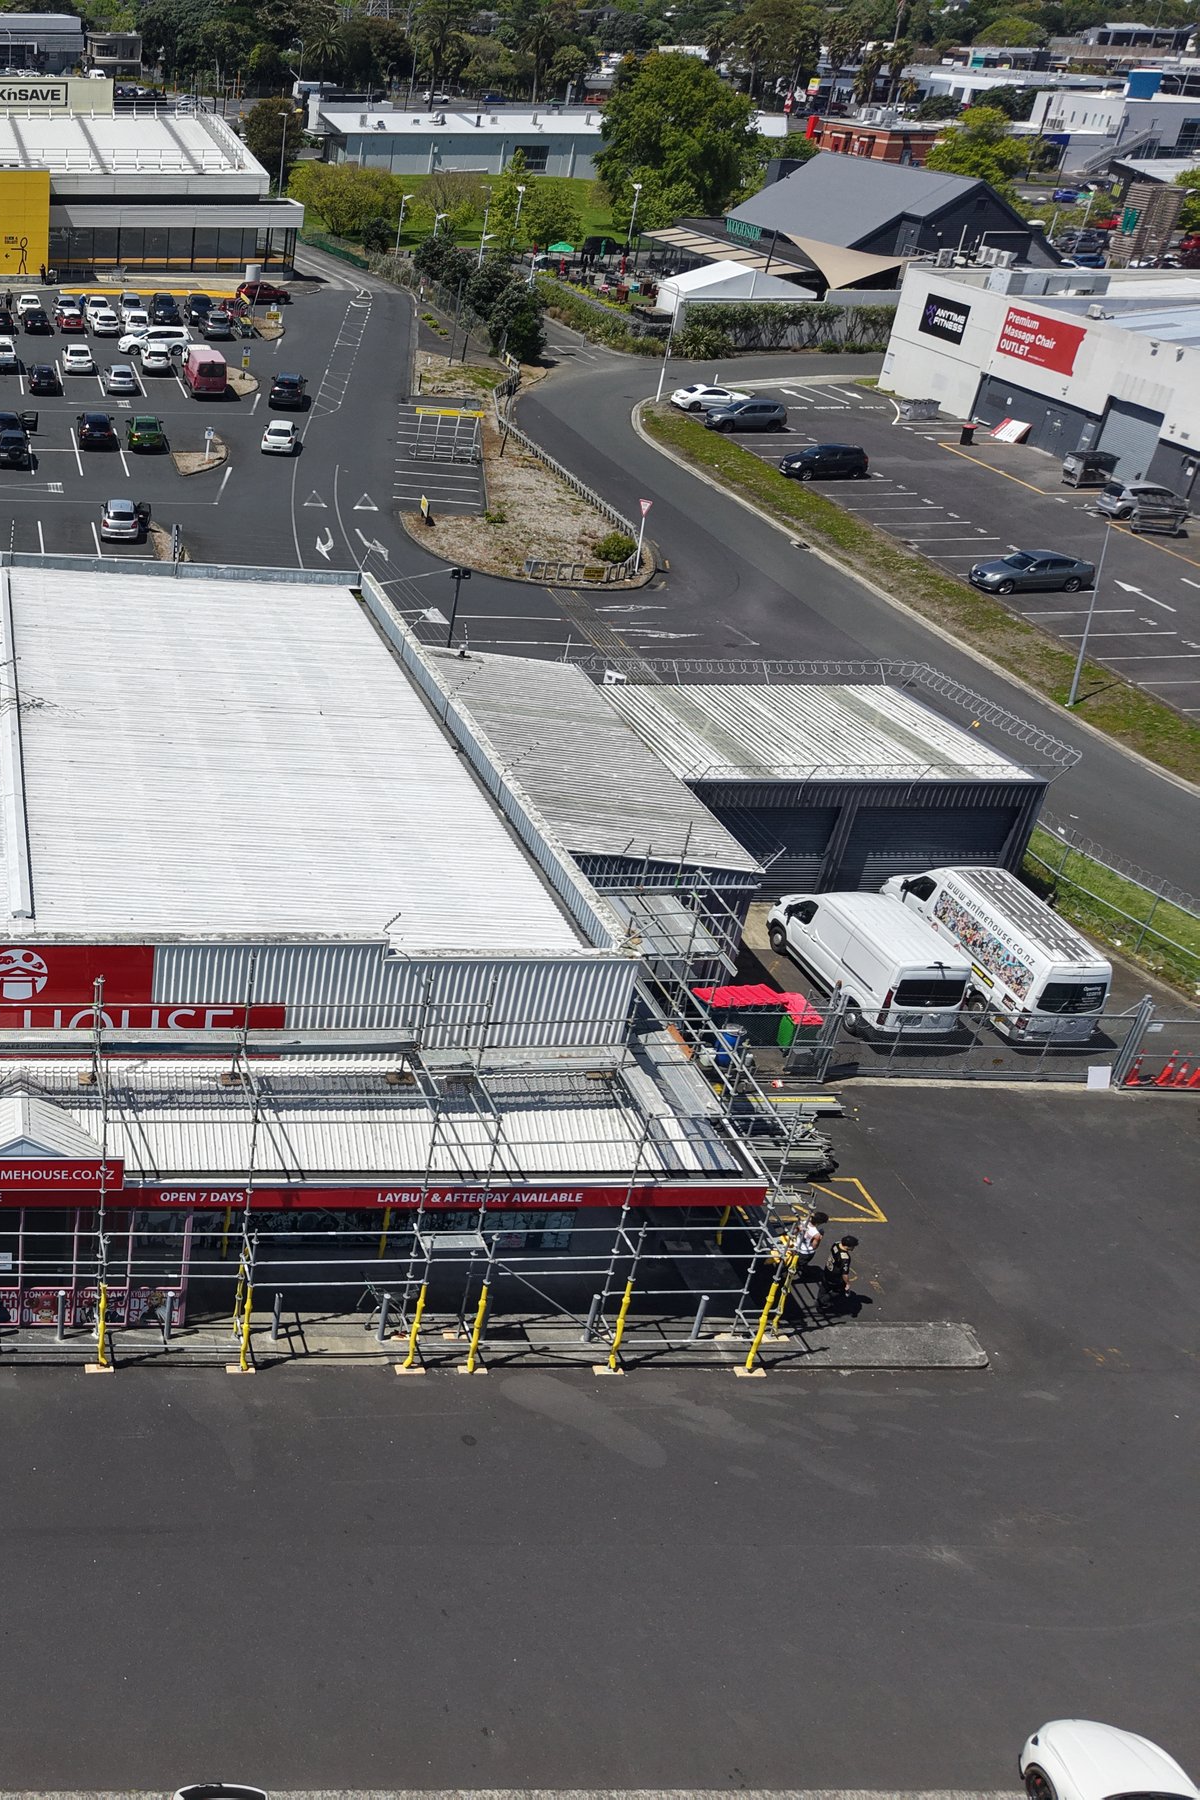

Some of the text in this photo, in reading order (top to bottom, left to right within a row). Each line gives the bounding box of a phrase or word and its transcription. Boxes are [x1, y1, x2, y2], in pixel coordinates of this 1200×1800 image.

[933, 316, 963, 333] FITNESS
[936, 308, 966, 324] ANYTIME
[1007, 311, 1040, 330] Premium
[1004, 324, 1057, 350] Massage Chair
[1000, 338, 1030, 357] OUTLET
[947, 881, 1036, 966] www.animehouse.co.nz
[160, 1192, 244, 1202] OPEN 7 DAYS
[377, 1192, 583, 1203] LAYBUY & AFTERPAY AVAILABLE
